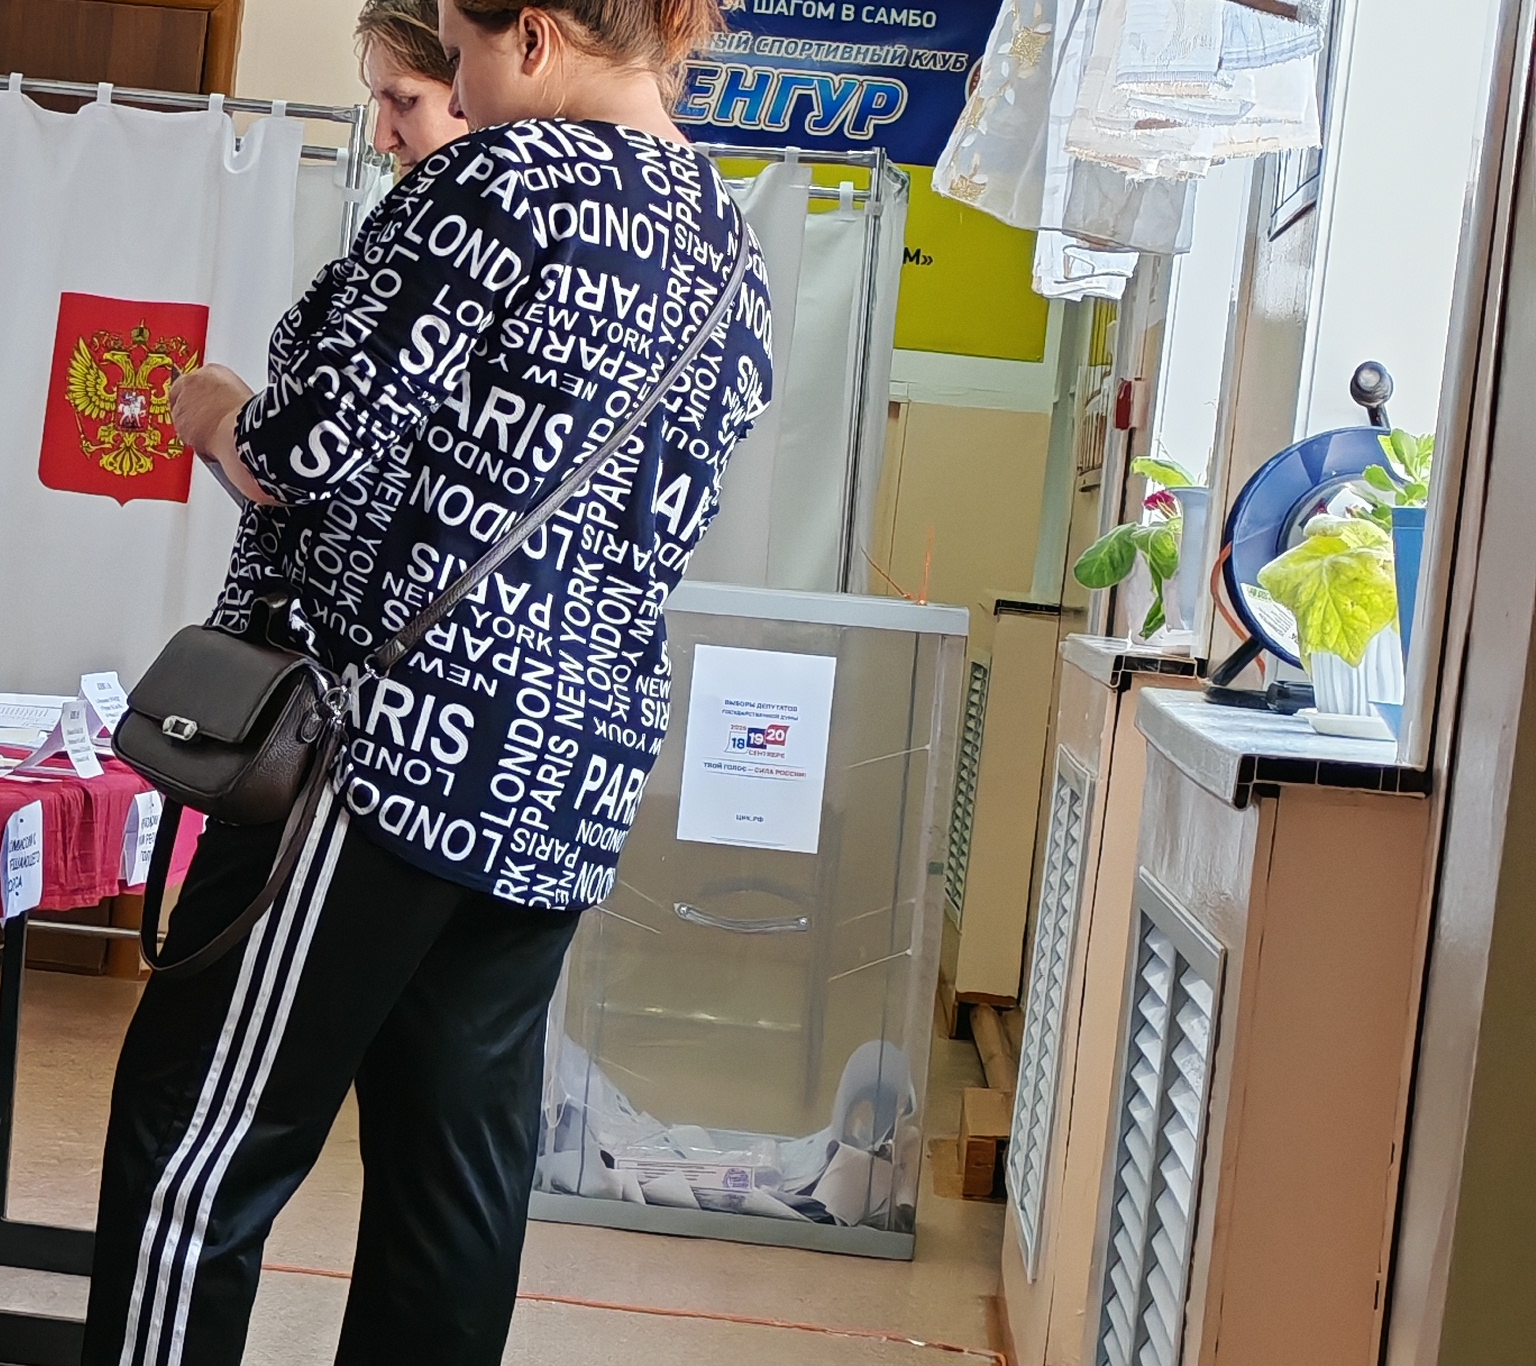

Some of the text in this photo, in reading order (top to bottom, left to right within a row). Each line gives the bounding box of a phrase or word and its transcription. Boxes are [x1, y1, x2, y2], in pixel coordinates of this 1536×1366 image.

[841, 3, 855, 22] В
[861, 6, 937, 29] САМБО
[711, 31, 970, 72] ЫЙ СПОРТИВНЫЙ КЛУБ
[517, 162, 623, 191] LOND
[534, 263, 659, 333] PARIS
[658, 251, 695, 345] YORK
[500, 318, 625, 380] PARIS
[589, 315, 654, 360] YORK
[522, 365, 599, 402] NEW
[559, 553, 604, 645] YORK
[470, 605, 553, 657] YORK
[588, 575, 643, 712] LONDON
[408, 652, 498, 698] NEW
[553, 649, 586, 731] NEW
[756, 702, 798, 712] ДЕПУТАТОВ
[480, 657, 555, 828] LONDON
[731, 729, 786, 749] 18 19 20
[520, 735, 579, 831] PARIS
[724, 764, 747, 772] ГОЛОС
[510, 827, 581, 868] PARIS
